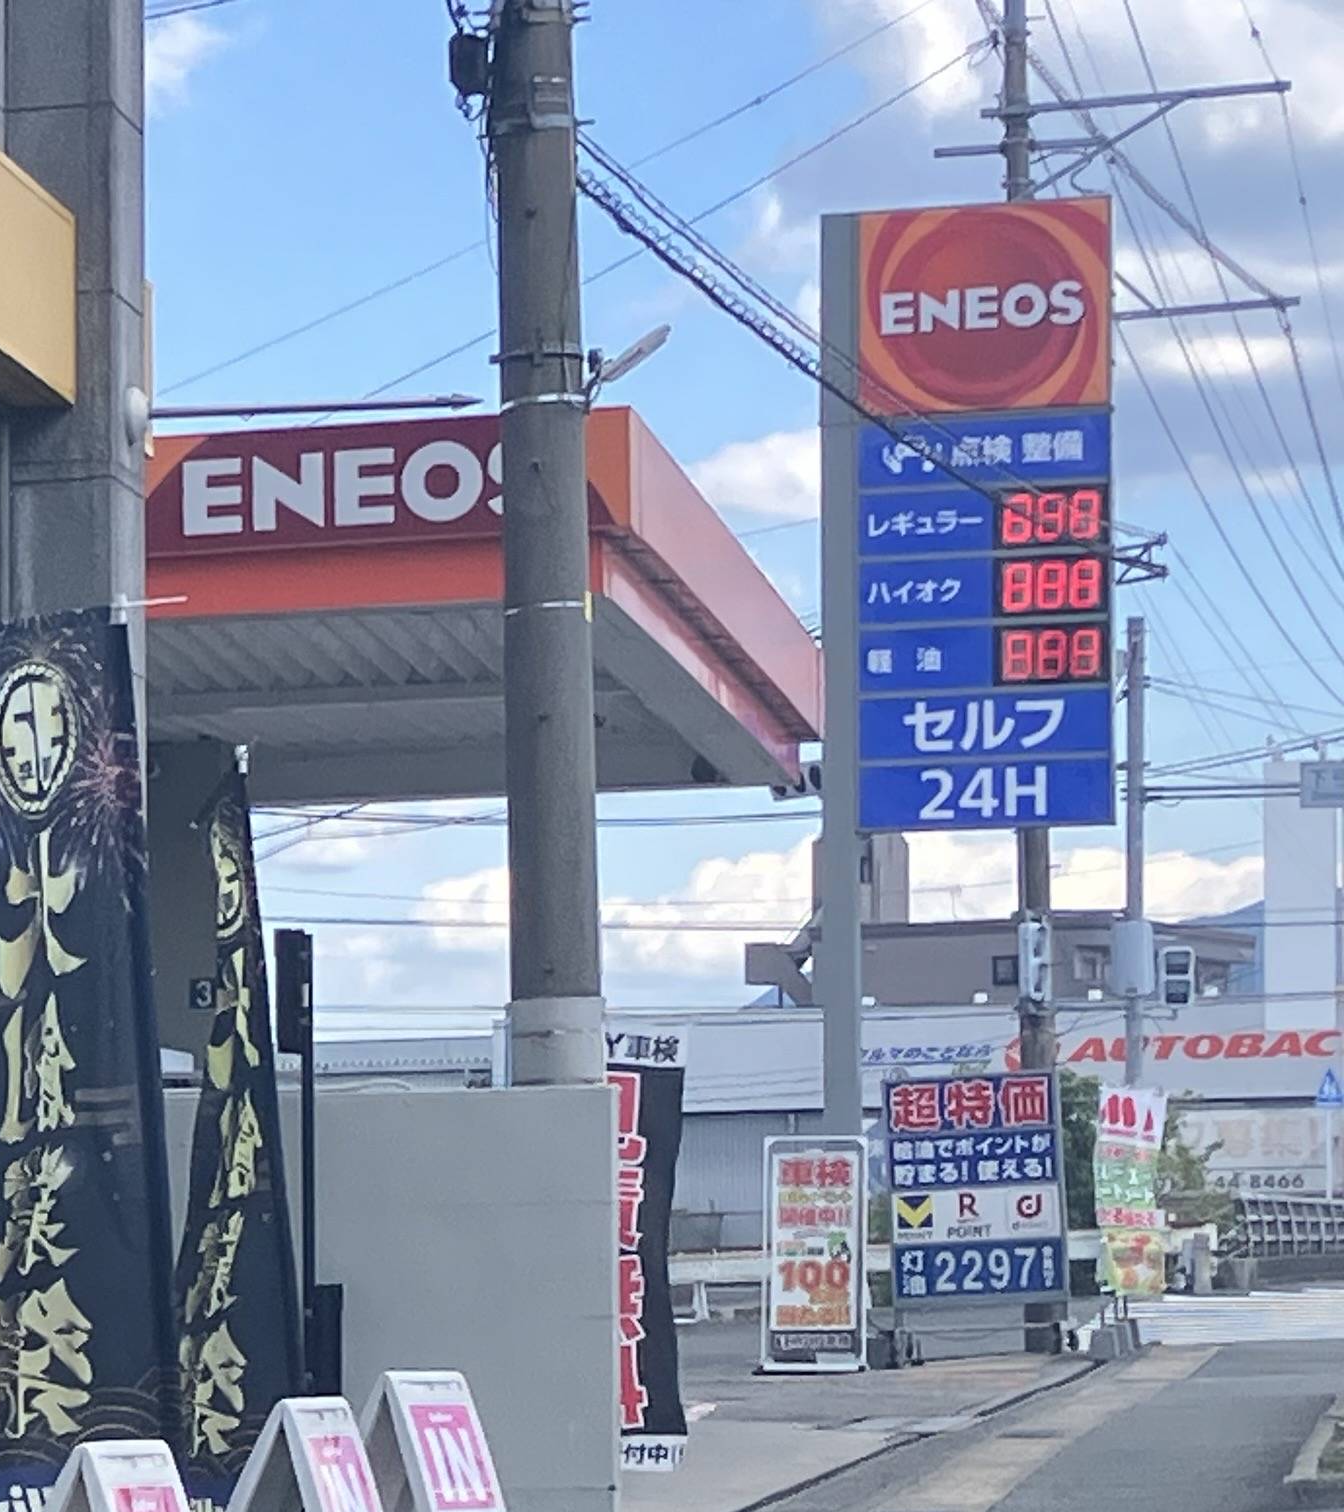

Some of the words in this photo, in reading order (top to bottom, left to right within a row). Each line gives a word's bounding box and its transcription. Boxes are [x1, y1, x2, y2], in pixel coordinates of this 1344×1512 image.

[879, 279, 1085, 337] ENEOS
[867, 510, 985, 538] レギュラー
[867, 578, 962, 604] ハイオク
[903, 698, 1066, 753] セルフ
[918, 764, 1049, 822] 24H
[889, 1075, 1050, 1134] 超特価
[933, 1247, 1037, 1294] 2297
